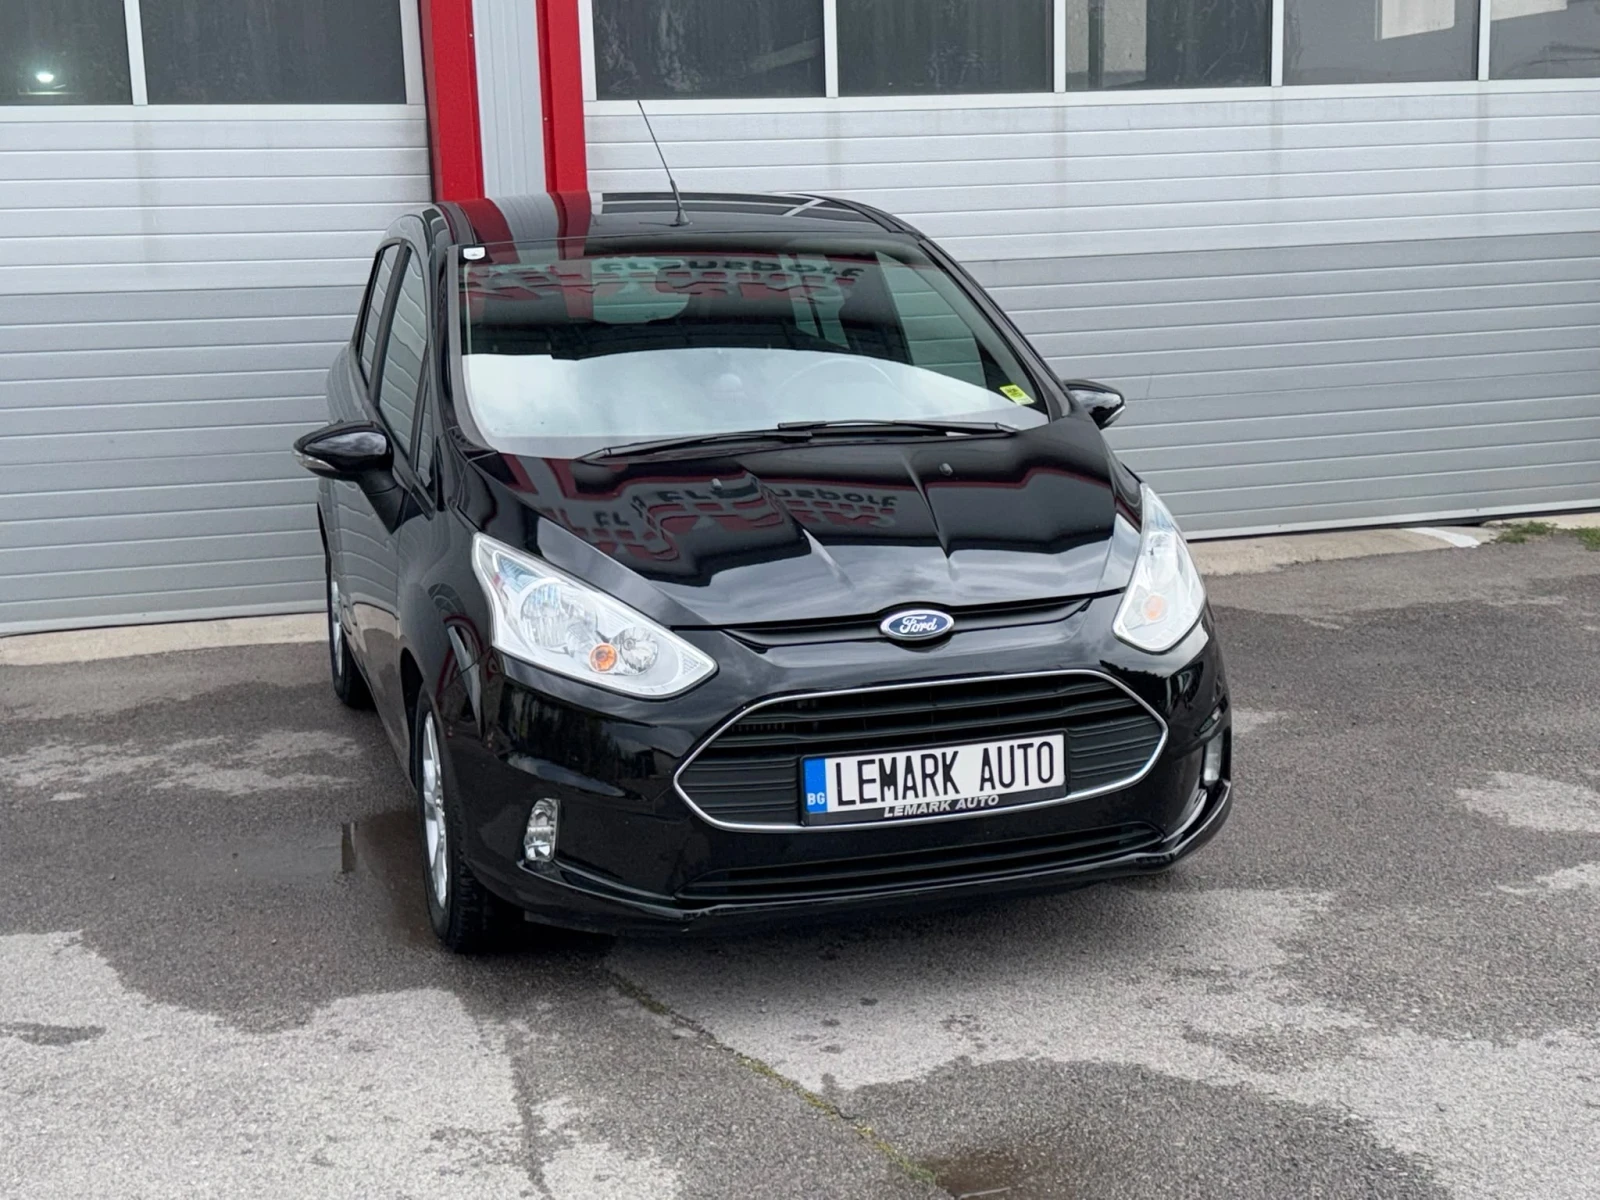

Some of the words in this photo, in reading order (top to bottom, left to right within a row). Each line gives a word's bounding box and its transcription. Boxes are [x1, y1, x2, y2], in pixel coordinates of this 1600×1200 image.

[899, 615, 938, 634] Ford
[835, 751, 960, 806] LEMARK
[979, 741, 1055, 792] AUTO
[806, 792, 826, 806] BG
[883, 800, 952, 818] LEMARK
[955, 794, 999, 810] AUTO
